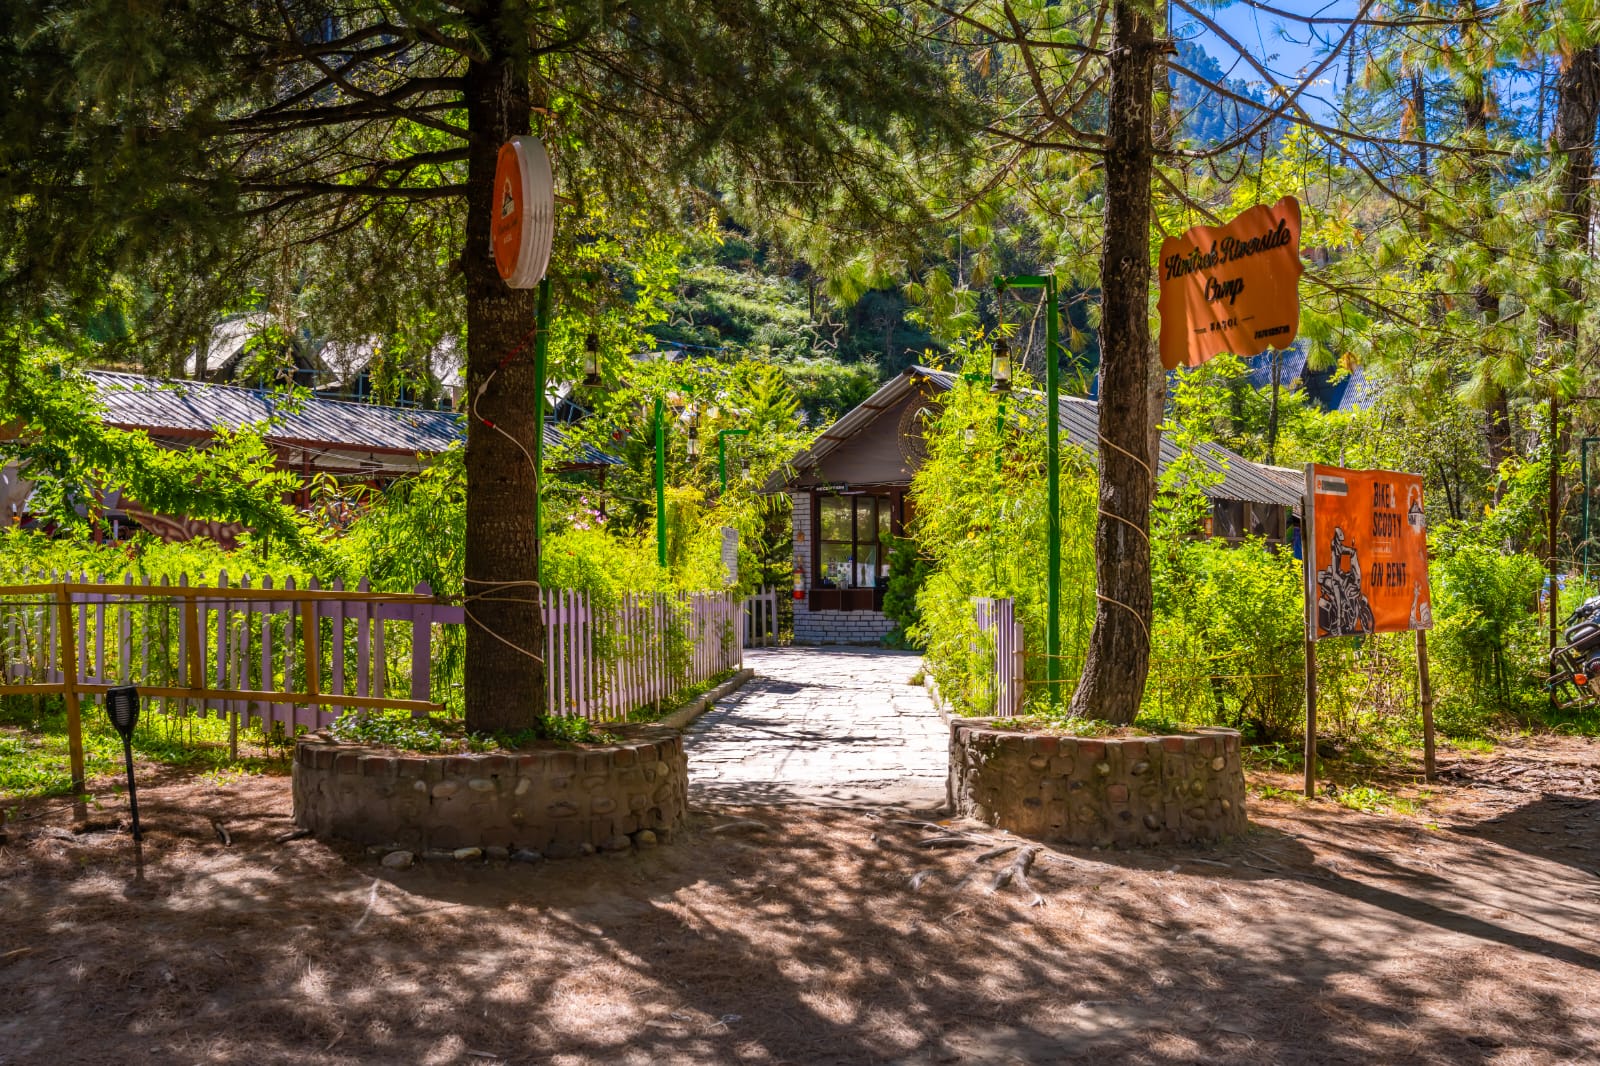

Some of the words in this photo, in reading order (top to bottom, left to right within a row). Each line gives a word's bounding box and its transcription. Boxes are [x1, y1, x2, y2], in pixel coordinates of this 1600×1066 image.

[1220, 218, 1291, 264] Riverside
[1205, 277, 1244, 305] Camp
[1373, 511, 1401, 538] SCOOTY
[1371, 562, 1383, 587] ON
[1386, 562, 1406, 587] RENT
